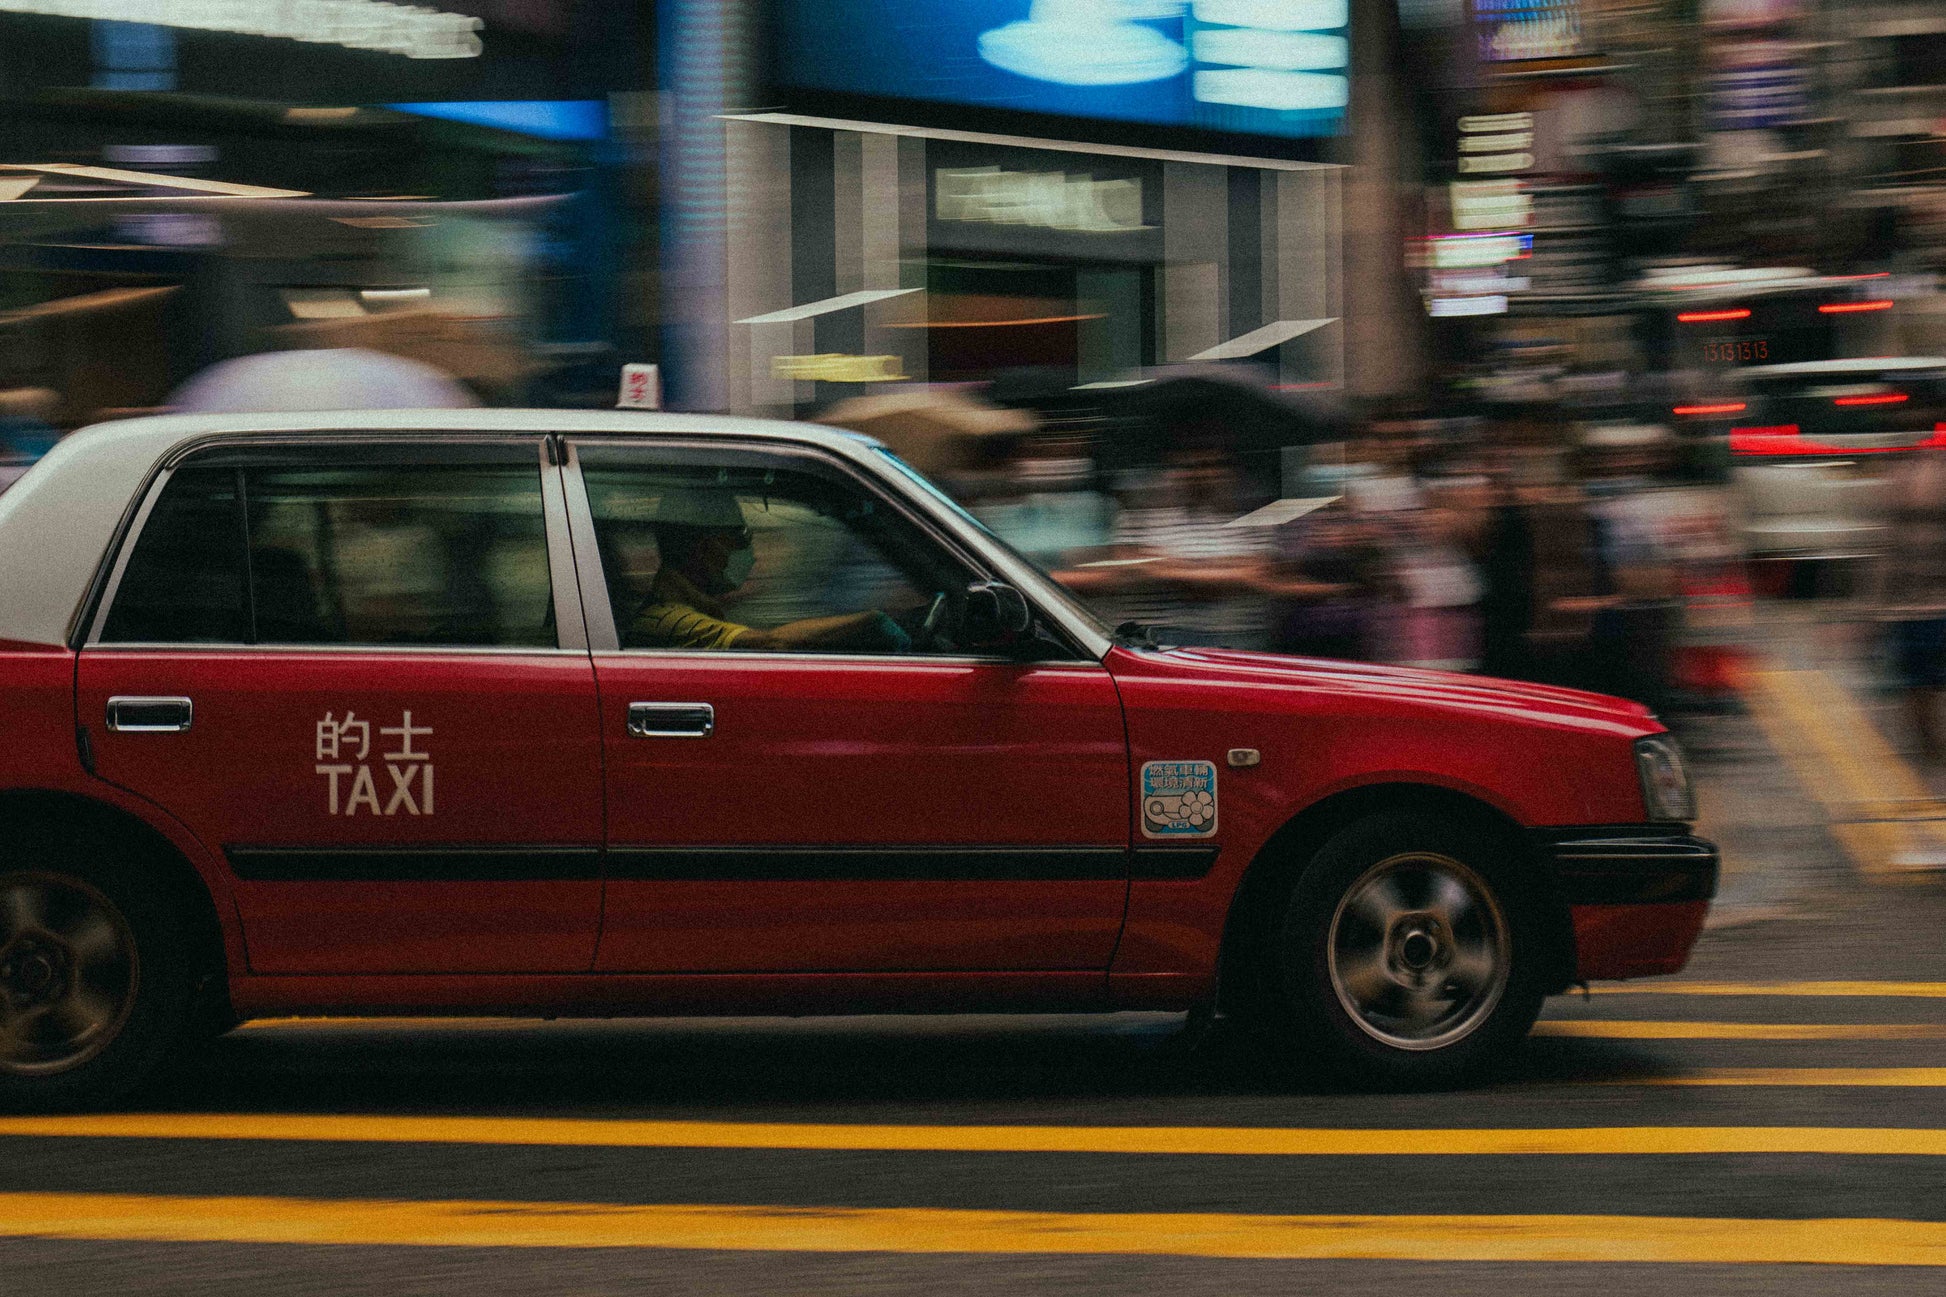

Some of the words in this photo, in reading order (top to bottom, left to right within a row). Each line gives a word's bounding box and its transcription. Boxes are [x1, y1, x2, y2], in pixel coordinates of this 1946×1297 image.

[316, 710, 434, 761] 的士
[315, 763, 434, 816] TAXI
[1171, 821, 1187, 829] LPG
